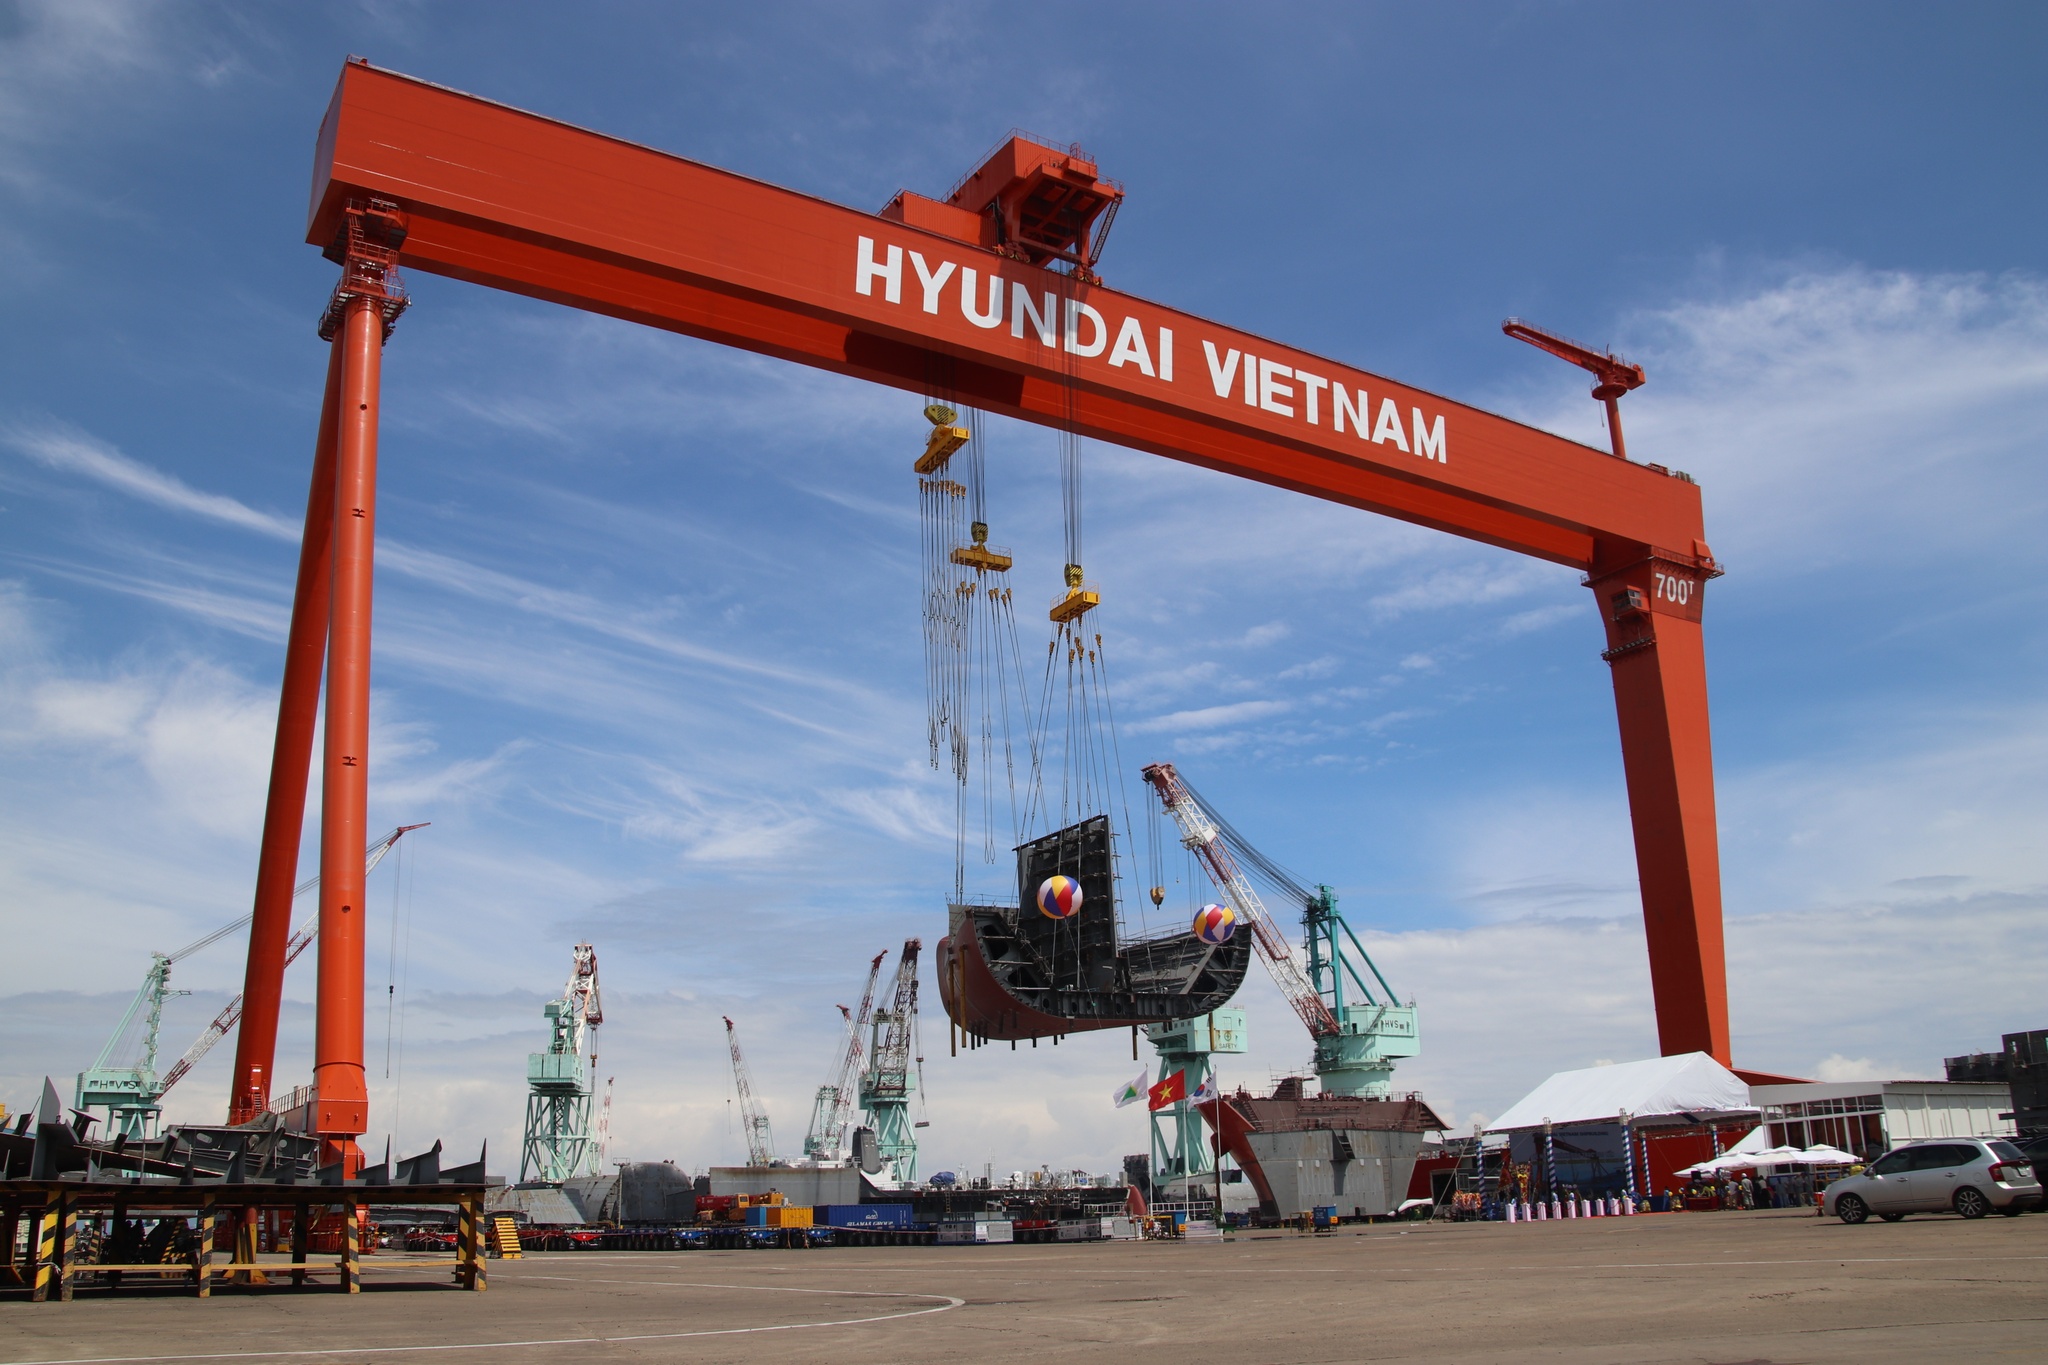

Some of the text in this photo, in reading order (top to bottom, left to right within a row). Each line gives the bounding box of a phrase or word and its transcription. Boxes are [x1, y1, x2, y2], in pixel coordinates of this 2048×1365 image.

[855, 235, 1447, 464] HYUNDAI VIETNAM
[1385, 1020, 1399, 1029] HVS
[99, 1080, 136, 1090] HVS
